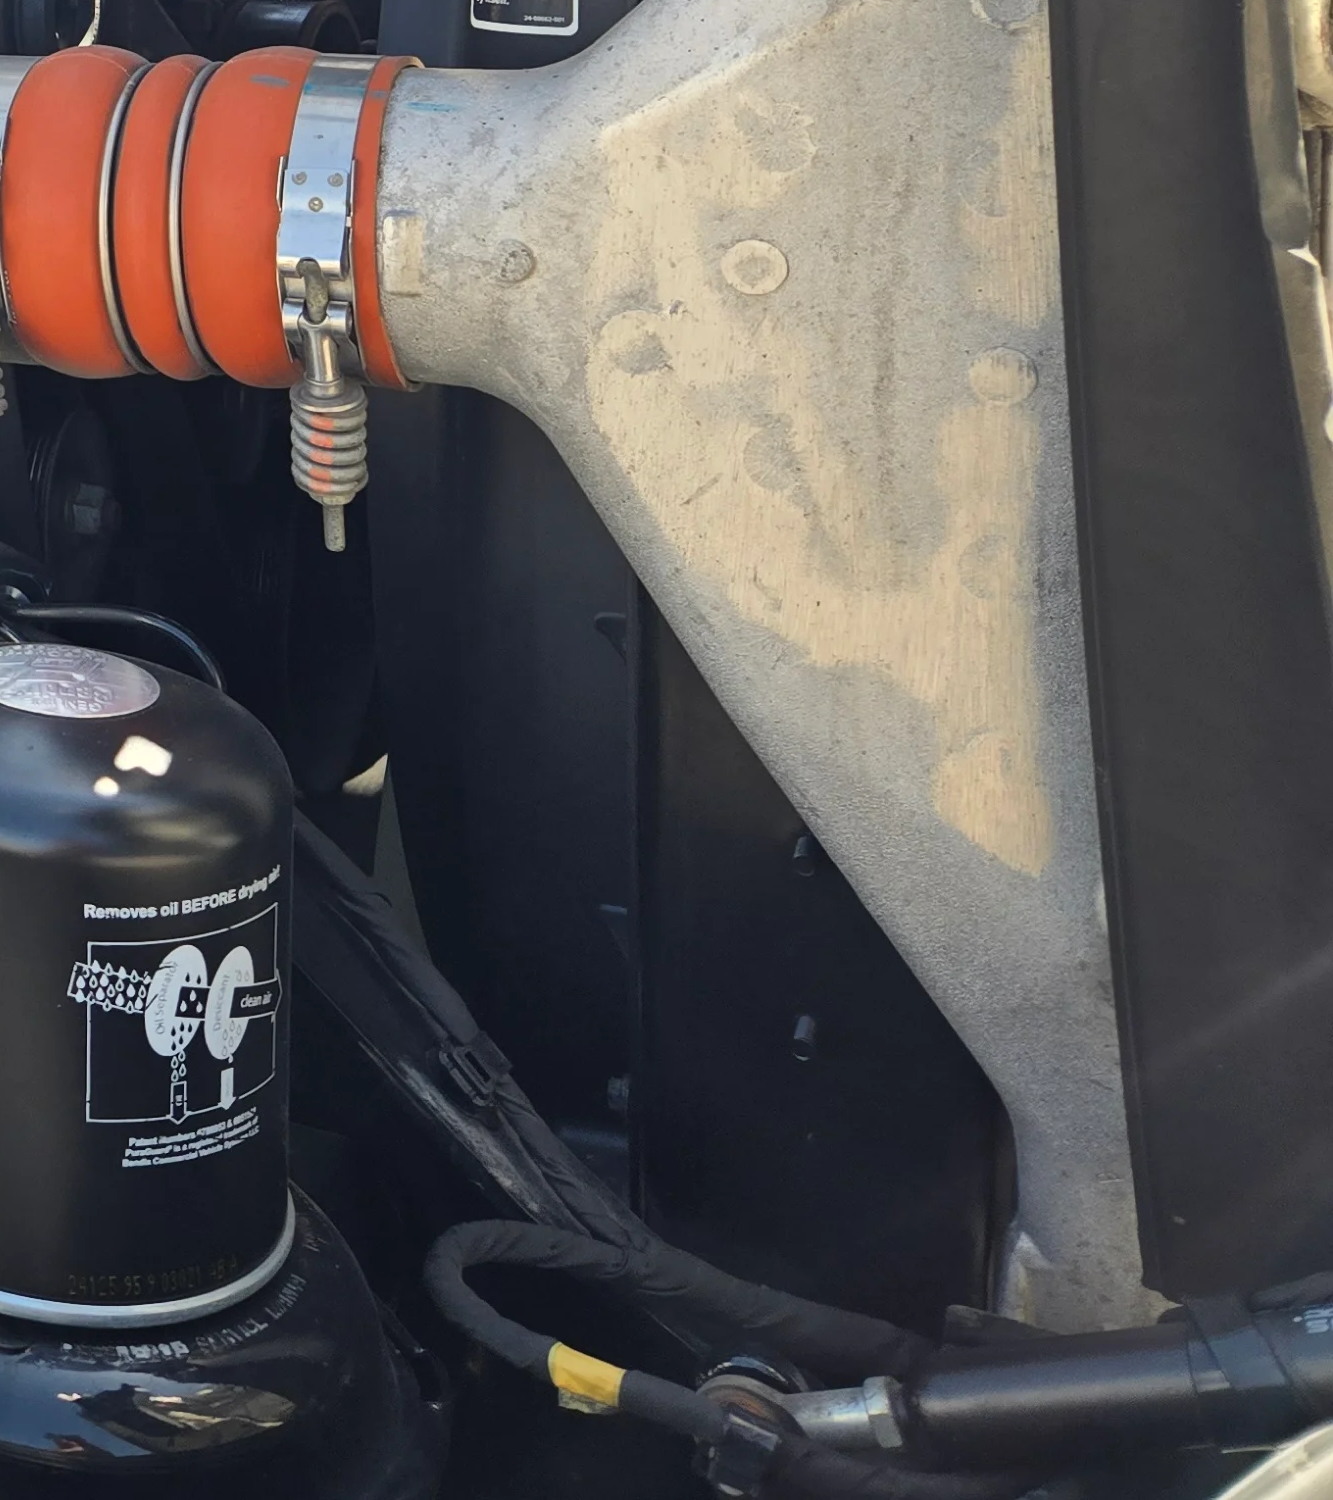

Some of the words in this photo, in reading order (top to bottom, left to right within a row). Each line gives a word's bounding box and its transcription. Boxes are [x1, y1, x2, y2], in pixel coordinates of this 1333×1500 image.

[84, 903, 157, 919] Removes
[160, 902, 178, 917] oil
[182, 889, 236, 914] BEFORE
[238, 876, 268, 900] drying
[240, 993, 261, 1009] clean
[262, 991, 273, 1005] air
